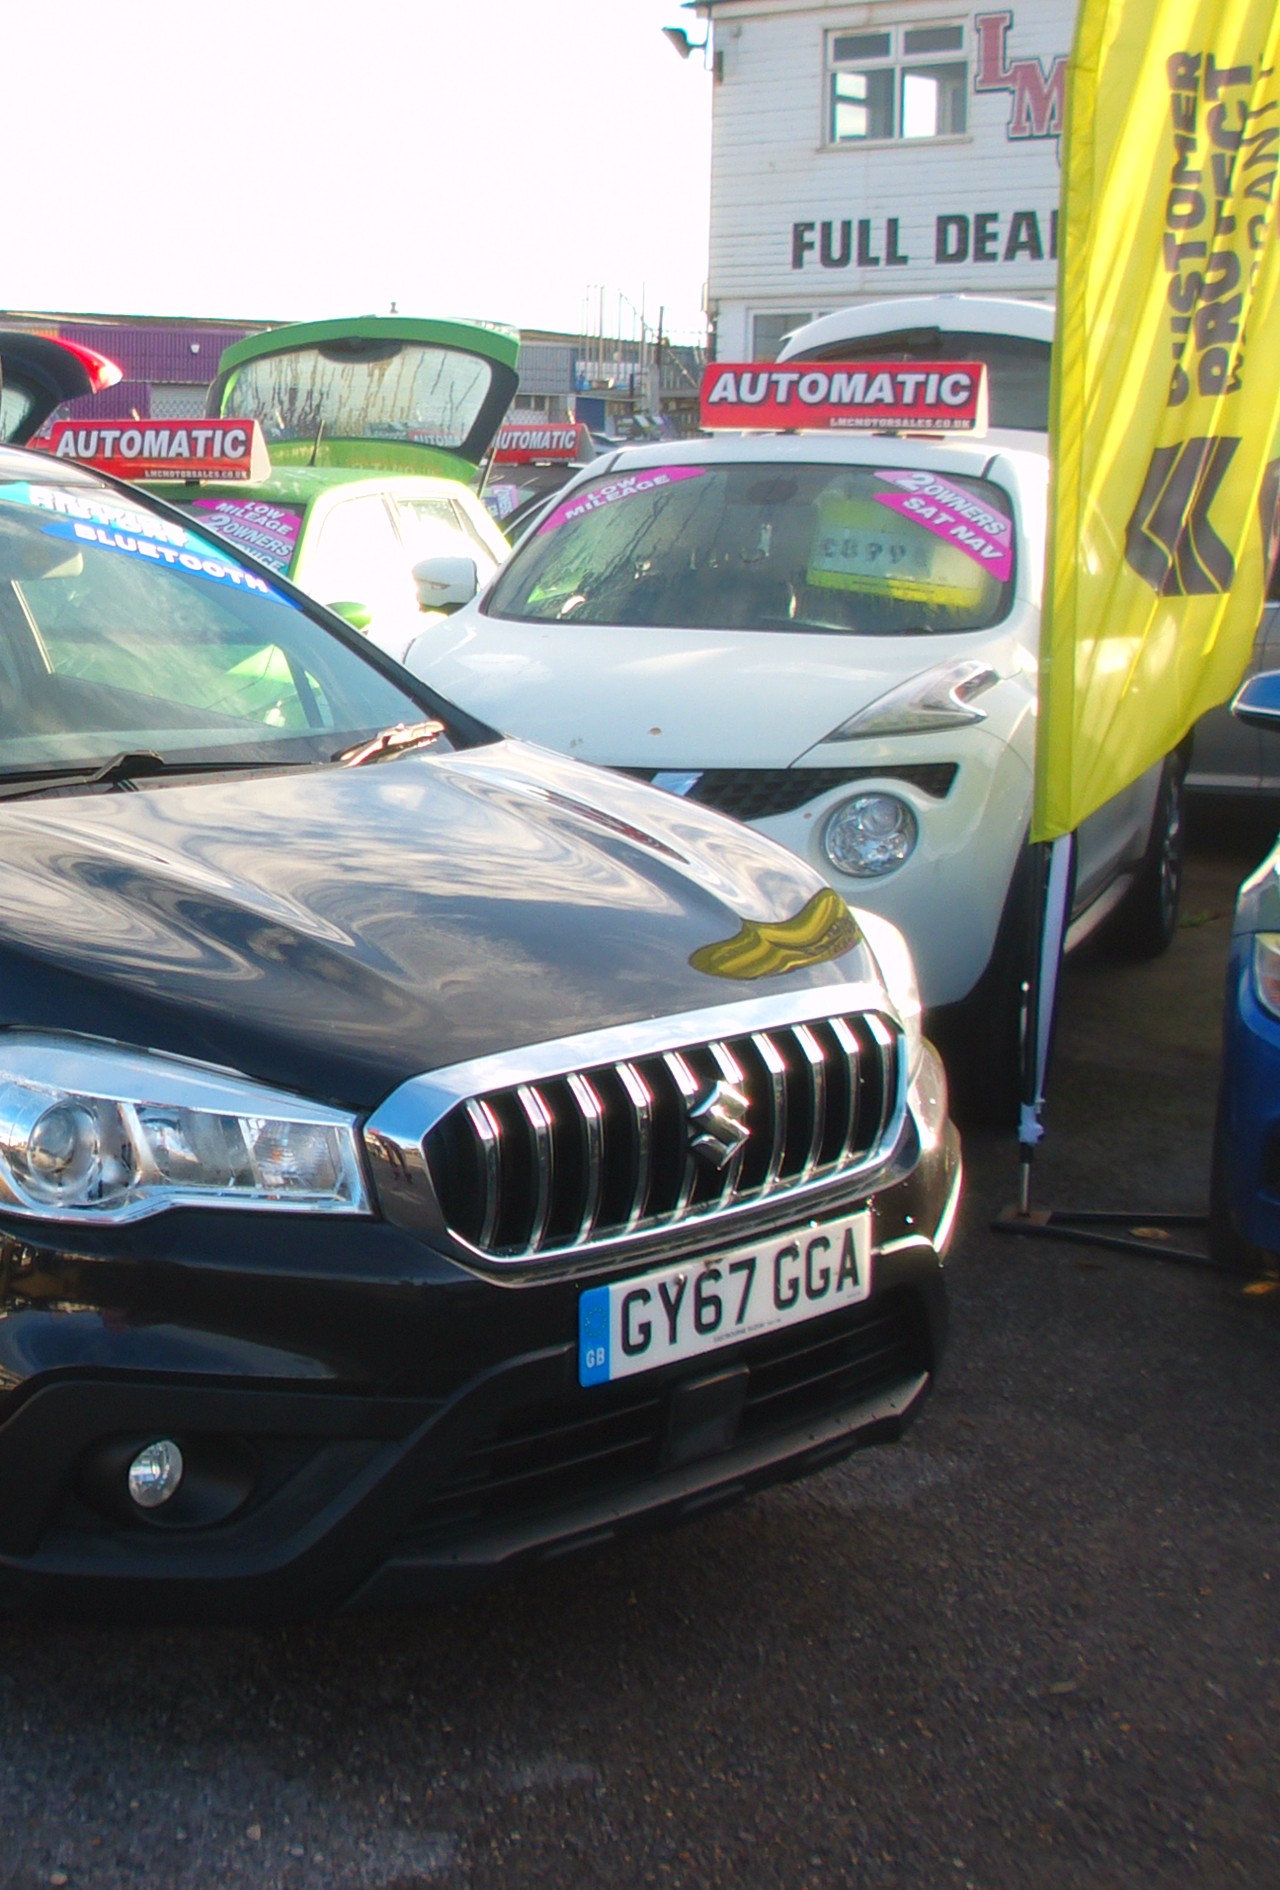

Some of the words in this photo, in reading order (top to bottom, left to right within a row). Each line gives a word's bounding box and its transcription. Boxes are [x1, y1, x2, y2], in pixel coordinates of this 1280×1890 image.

[791, 216, 909, 271] FULL
[708, 371, 971, 406] AUTOMATIC
[491, 430, 577, 449] AUTOMATIC
[829, 417, 971, 429] LMCMOTORSALES.CO.UK
[56, 429, 246, 459] AUTOMATIC
[144, 469, 248, 480] LMCMOTORSALES.CO.UK
[587, 476, 637, 501] LOW
[244, 502, 285, 519] LOW
[564, 474, 671, 520] MILEAGE
[894, 473, 936, 491] 2
[922, 484, 1007, 536] OWNERS
[215, 502, 294, 535] MILEAGE
[902, 497, 956, 525] SAT
[949, 525, 1006, 560] NAV
[223, 523, 294, 557] OWNERS
[73, 523, 270, 594] BLUETOOTH
[620, 1256, 758, 1357] GY67
[773, 1227, 861, 1312] GGA
[586, 1347, 605, 1369] GB
